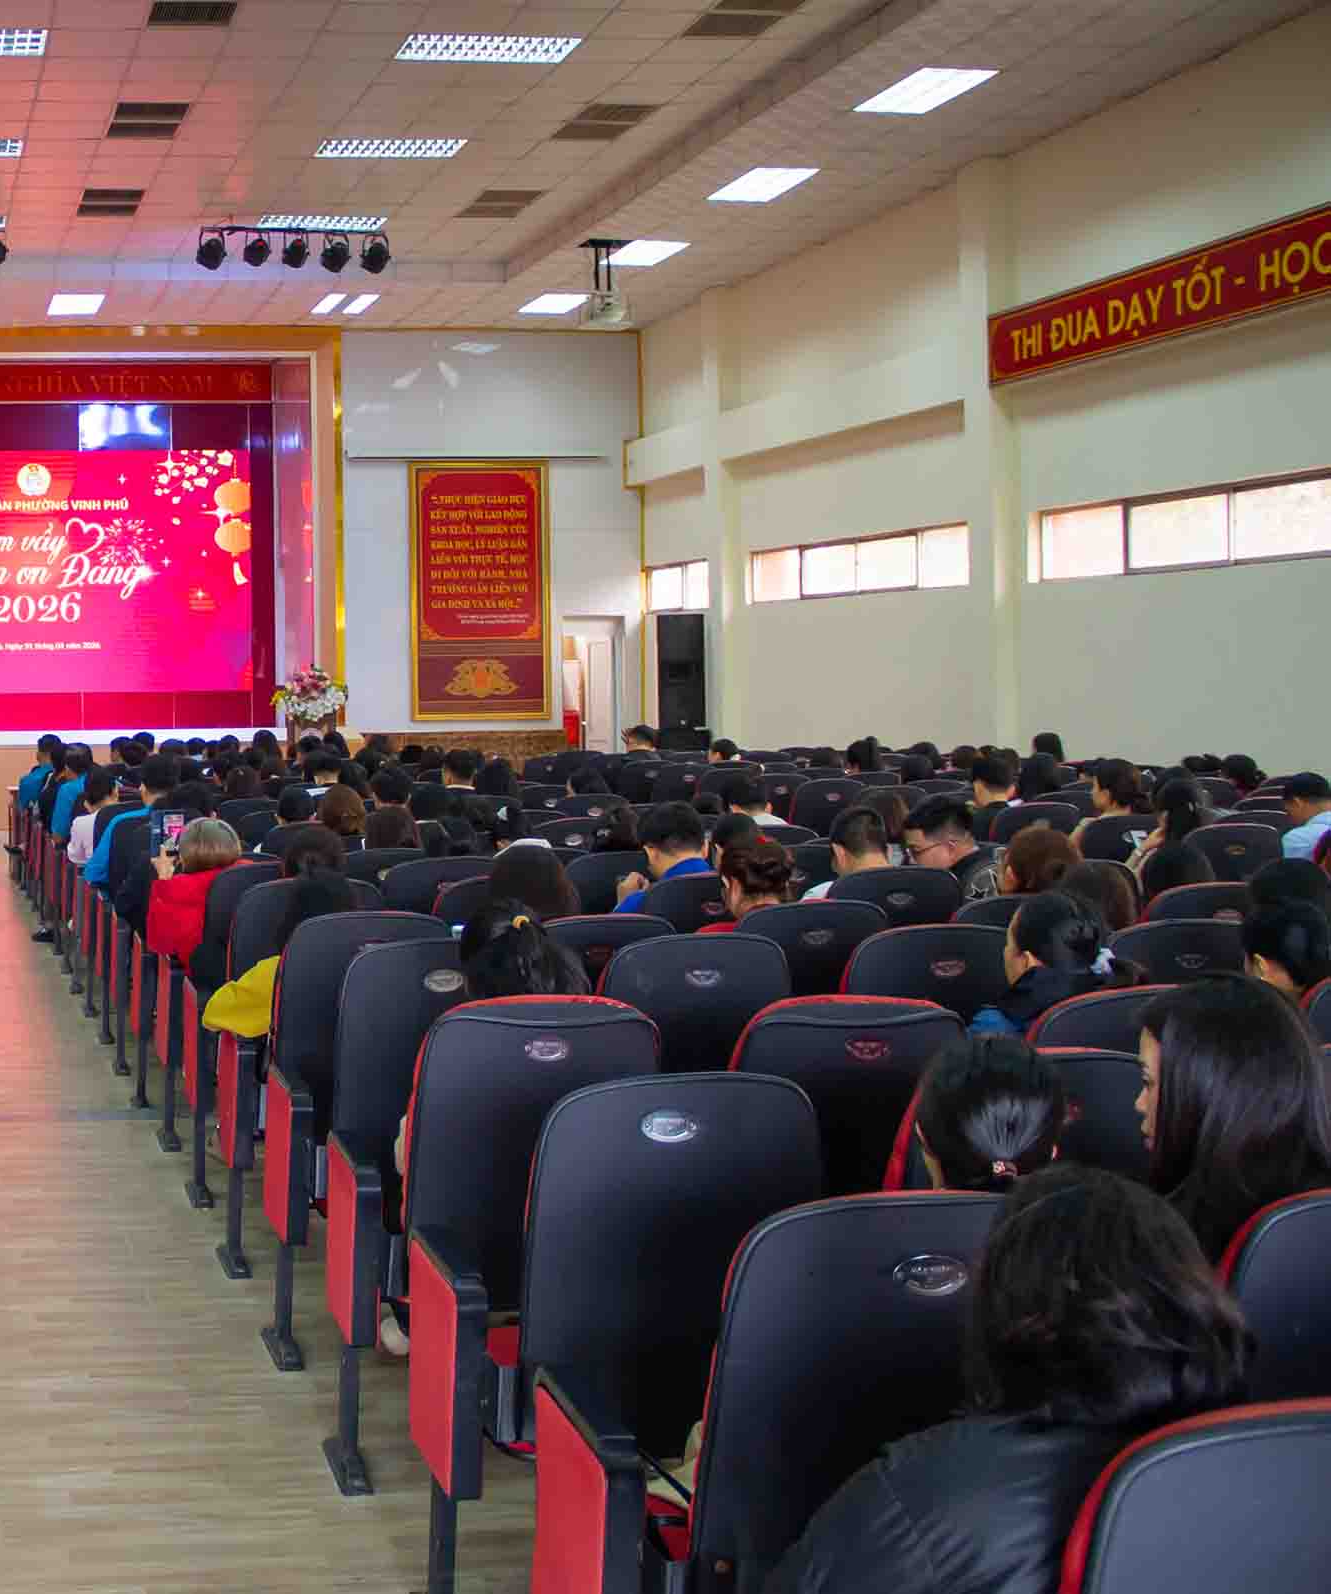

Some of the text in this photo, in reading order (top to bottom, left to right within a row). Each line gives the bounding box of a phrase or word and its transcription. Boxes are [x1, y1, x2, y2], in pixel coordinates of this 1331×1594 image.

[1010, 322, 1044, 363] THI
[1049, 305, 1101, 352] ĐUA
[1107, 284, 1165, 337] DẠY
[1172, 256, 1227, 317] TỐT
[103, 498, 129, 511] PHÚ
